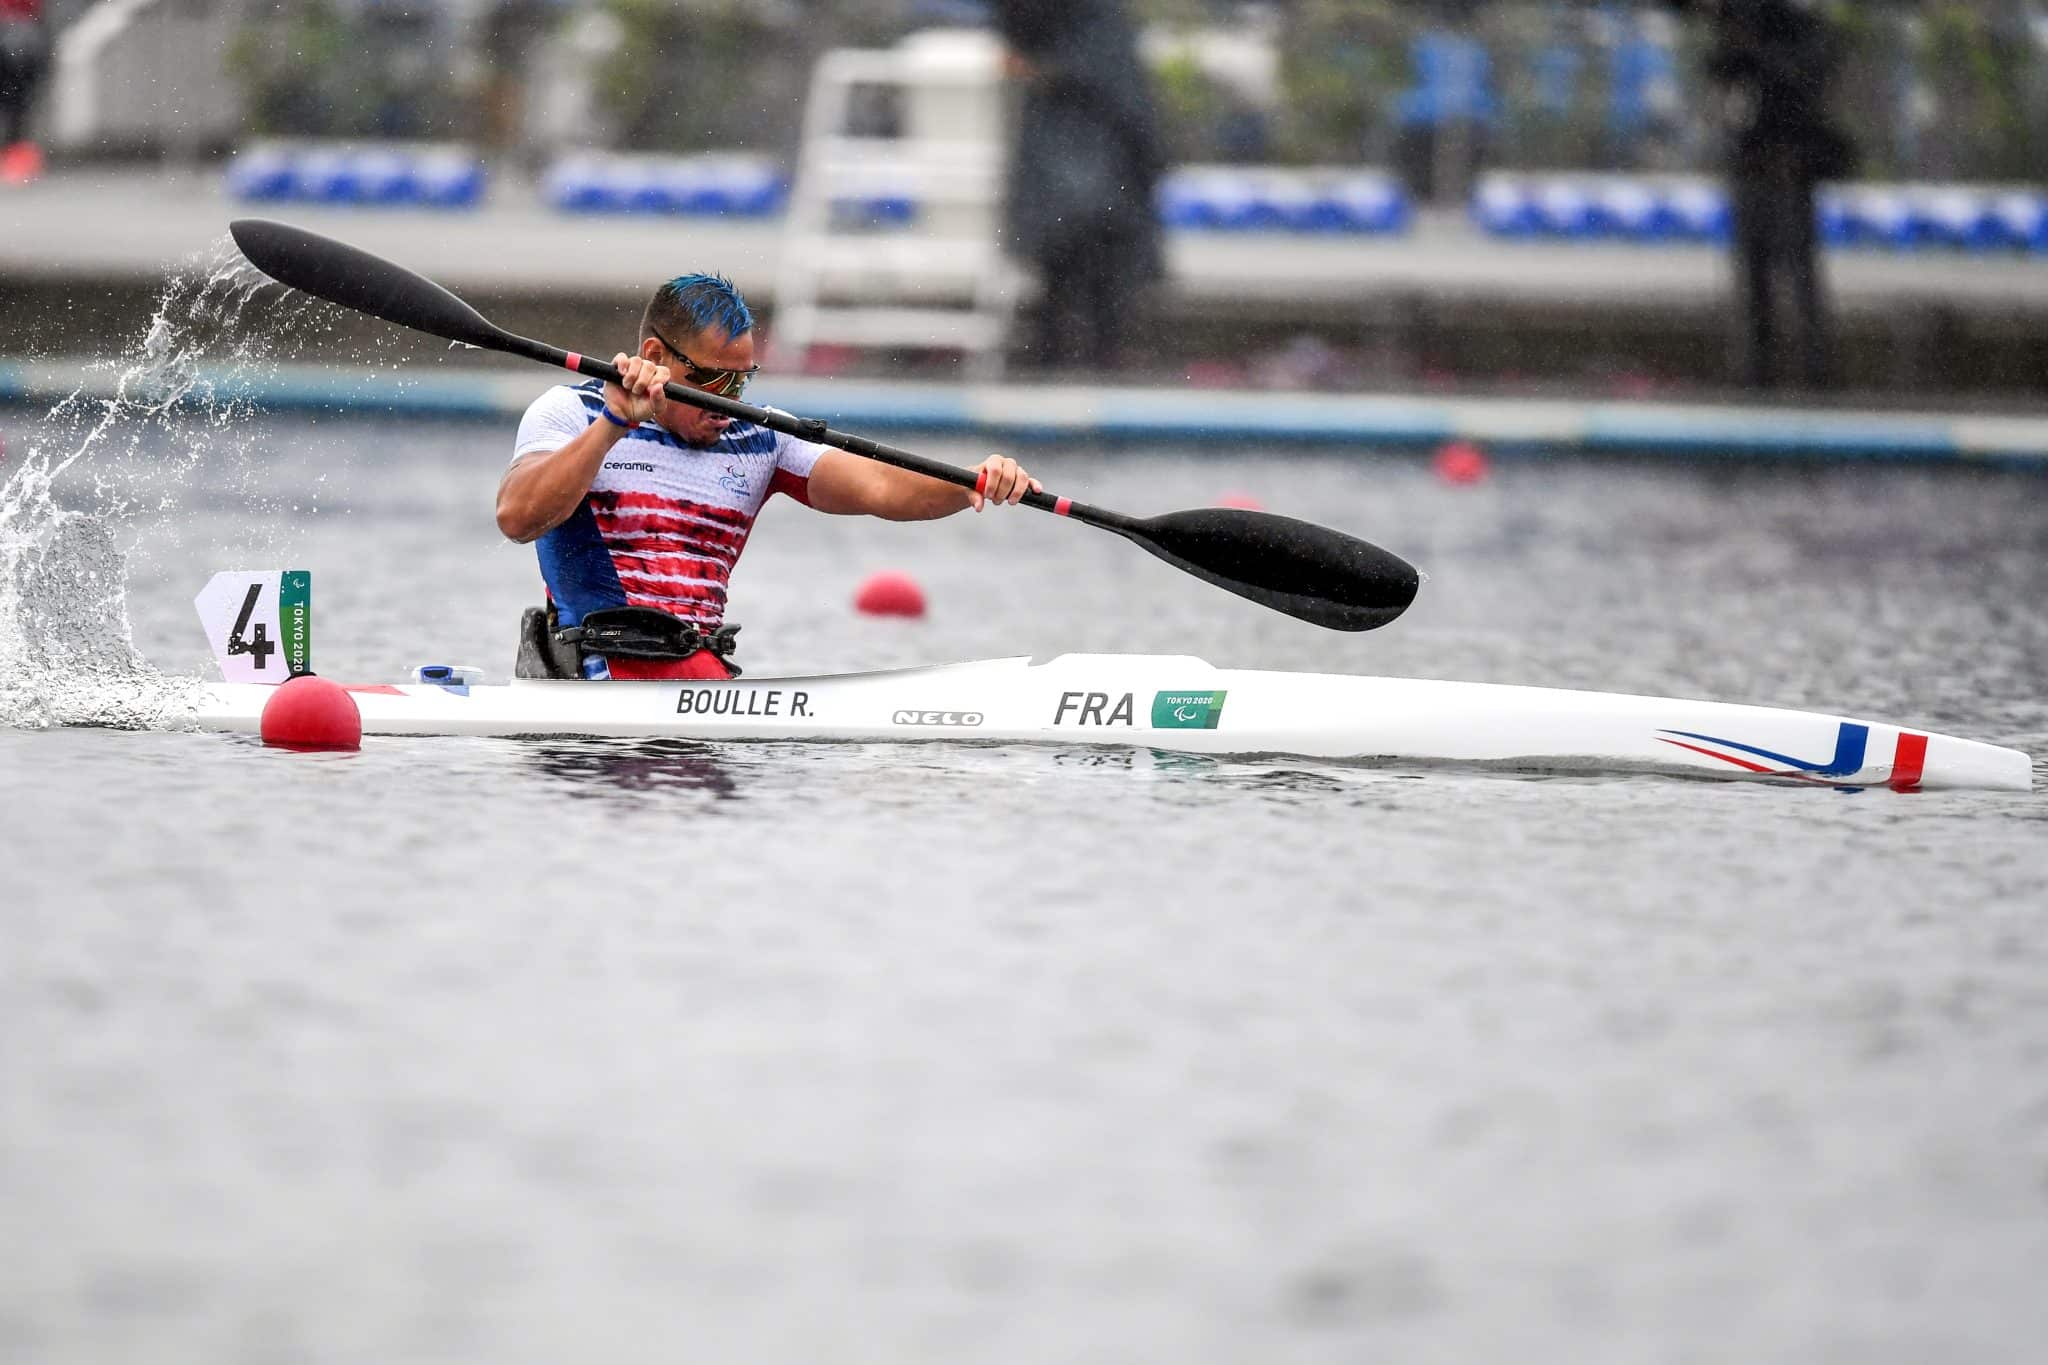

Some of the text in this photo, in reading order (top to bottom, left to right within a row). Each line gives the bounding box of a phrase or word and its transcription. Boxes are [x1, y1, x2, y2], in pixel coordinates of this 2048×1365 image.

[228, 583, 275, 670] 4
[293, 600, 304, 673] TOKYO 2020
[676, 689, 815, 717] BOULLE R.
[1053, 691, 1134, 726] FRA
[1166, 696, 1214, 705] TOKYO 2020
[895, 711, 982, 726] NELO
